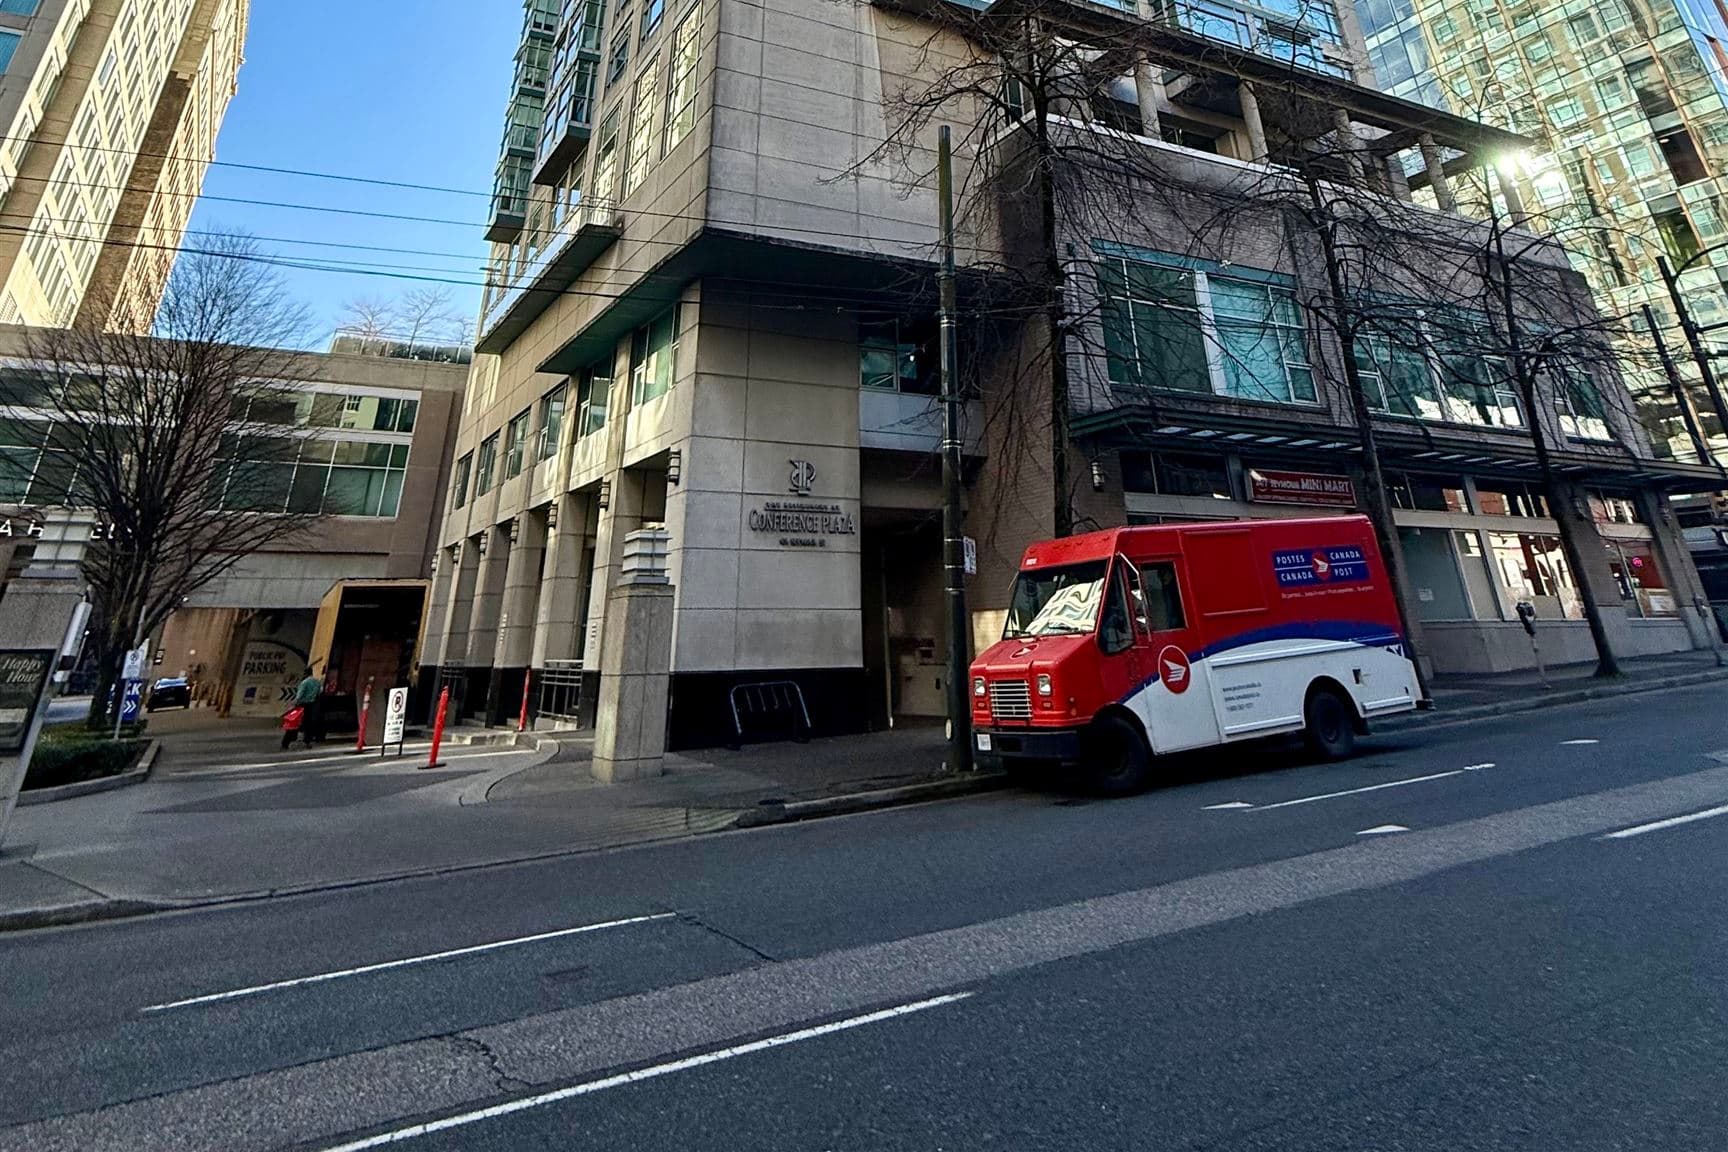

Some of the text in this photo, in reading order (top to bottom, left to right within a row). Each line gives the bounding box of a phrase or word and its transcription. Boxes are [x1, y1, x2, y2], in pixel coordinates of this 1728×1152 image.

[1301, 478, 1323, 491] MINI
[1324, 480, 1350, 493] MART
[749, 509, 856, 535] CONFERENCE PLAZA
[1276, 550, 1360, 564] POSTES CANADA
[1281, 567, 1353, 581] CANADA POST
[2, 658, 45, 672] Happy
[243, 661, 287, 675] PARKING
[6, 671, 41, 683] Hour
